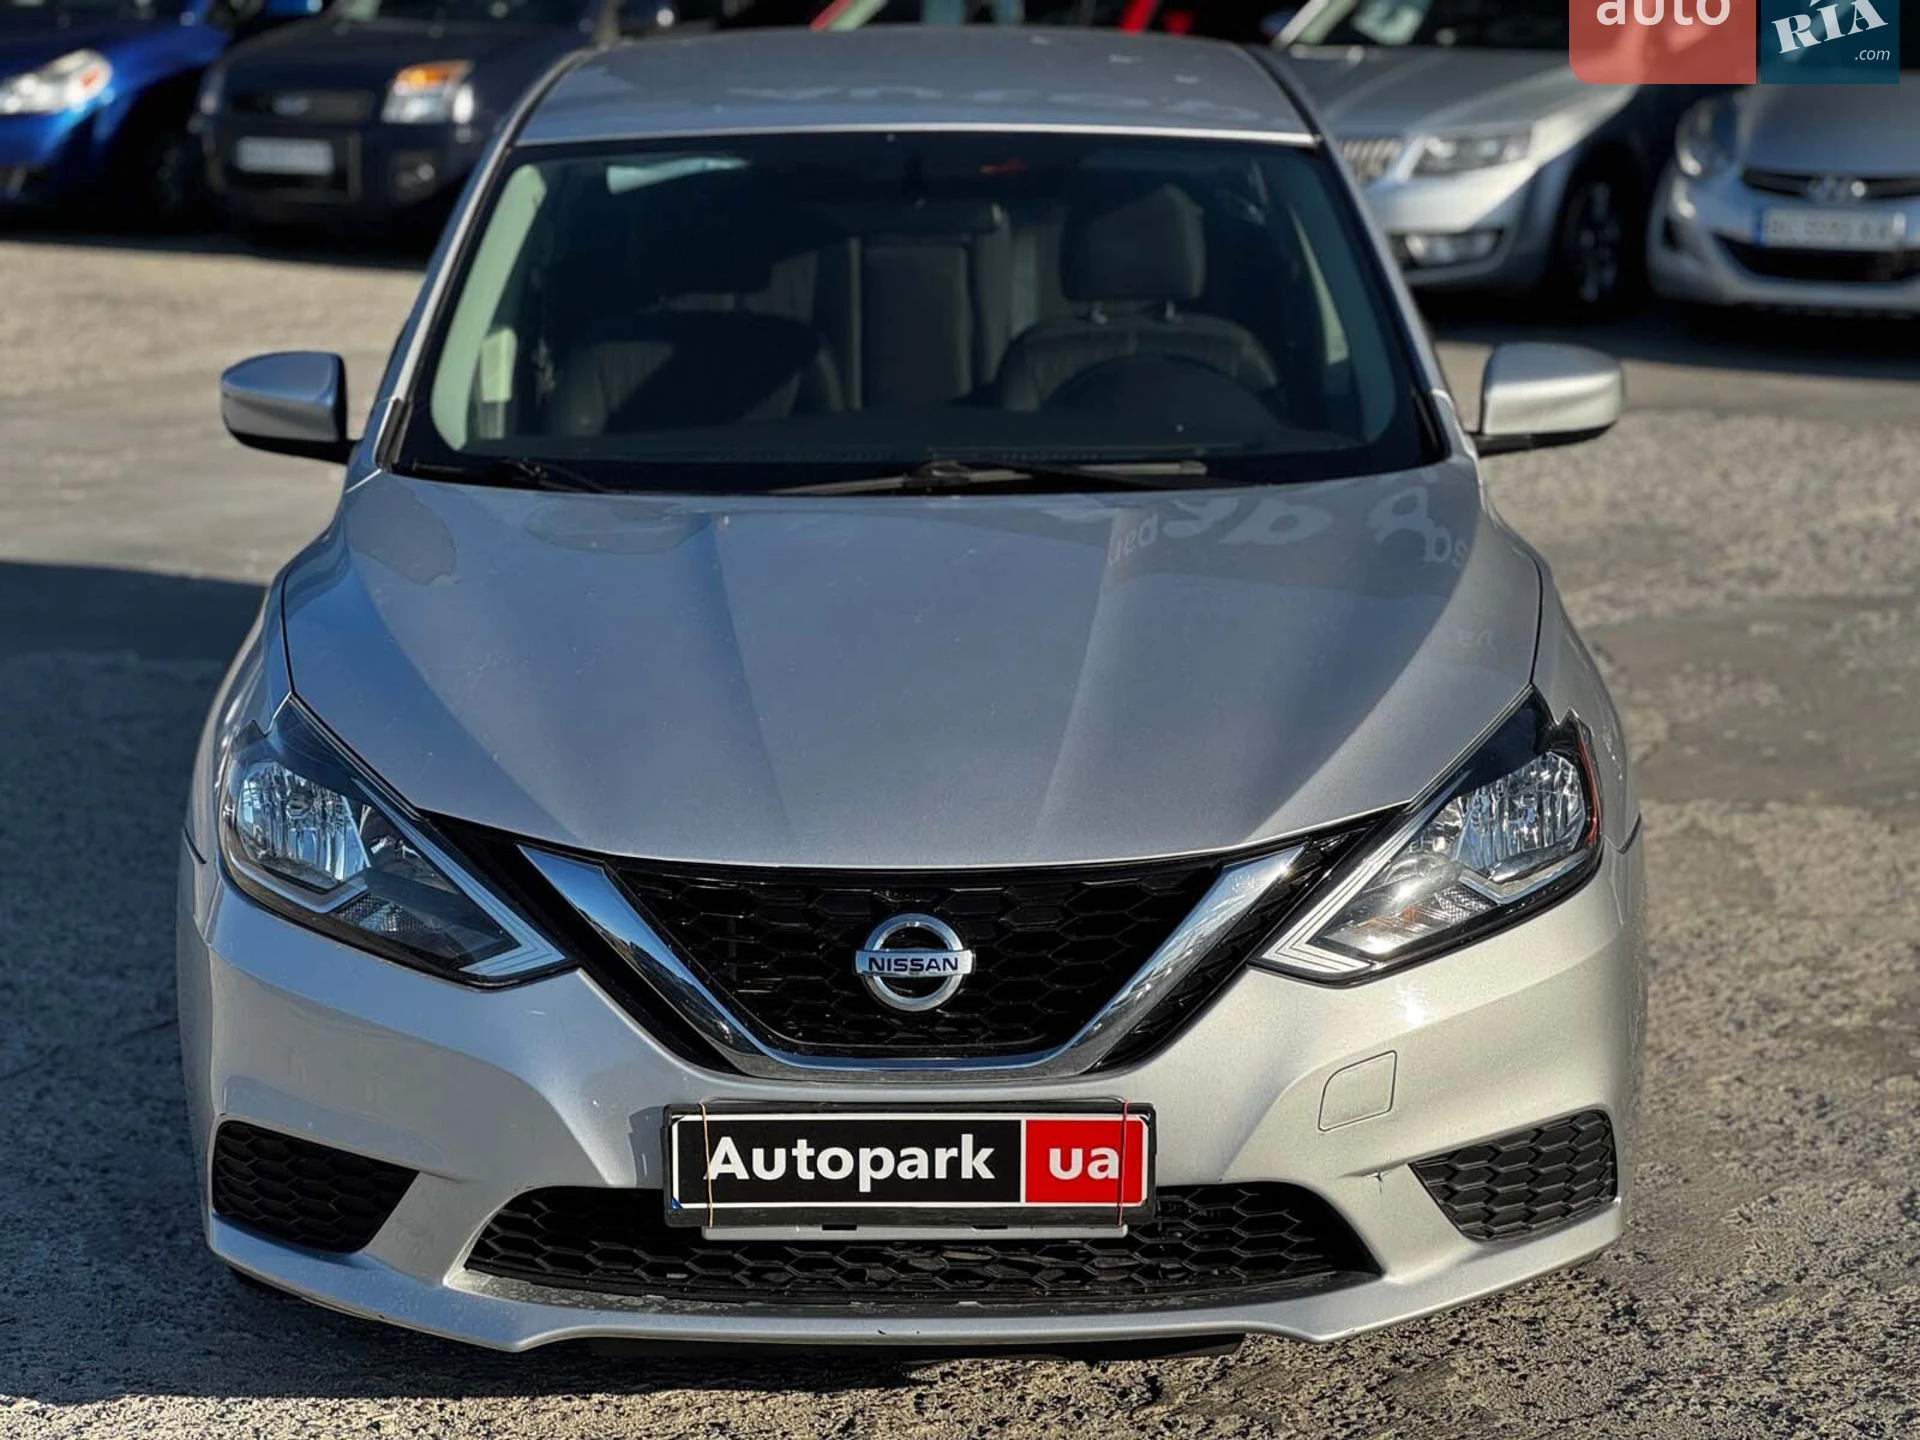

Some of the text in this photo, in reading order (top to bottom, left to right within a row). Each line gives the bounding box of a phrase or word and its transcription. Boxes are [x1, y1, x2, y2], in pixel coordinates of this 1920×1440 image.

[868, 957, 959, 972] NISSAN
[703, 1133, 1120, 1193] Autopark ua
